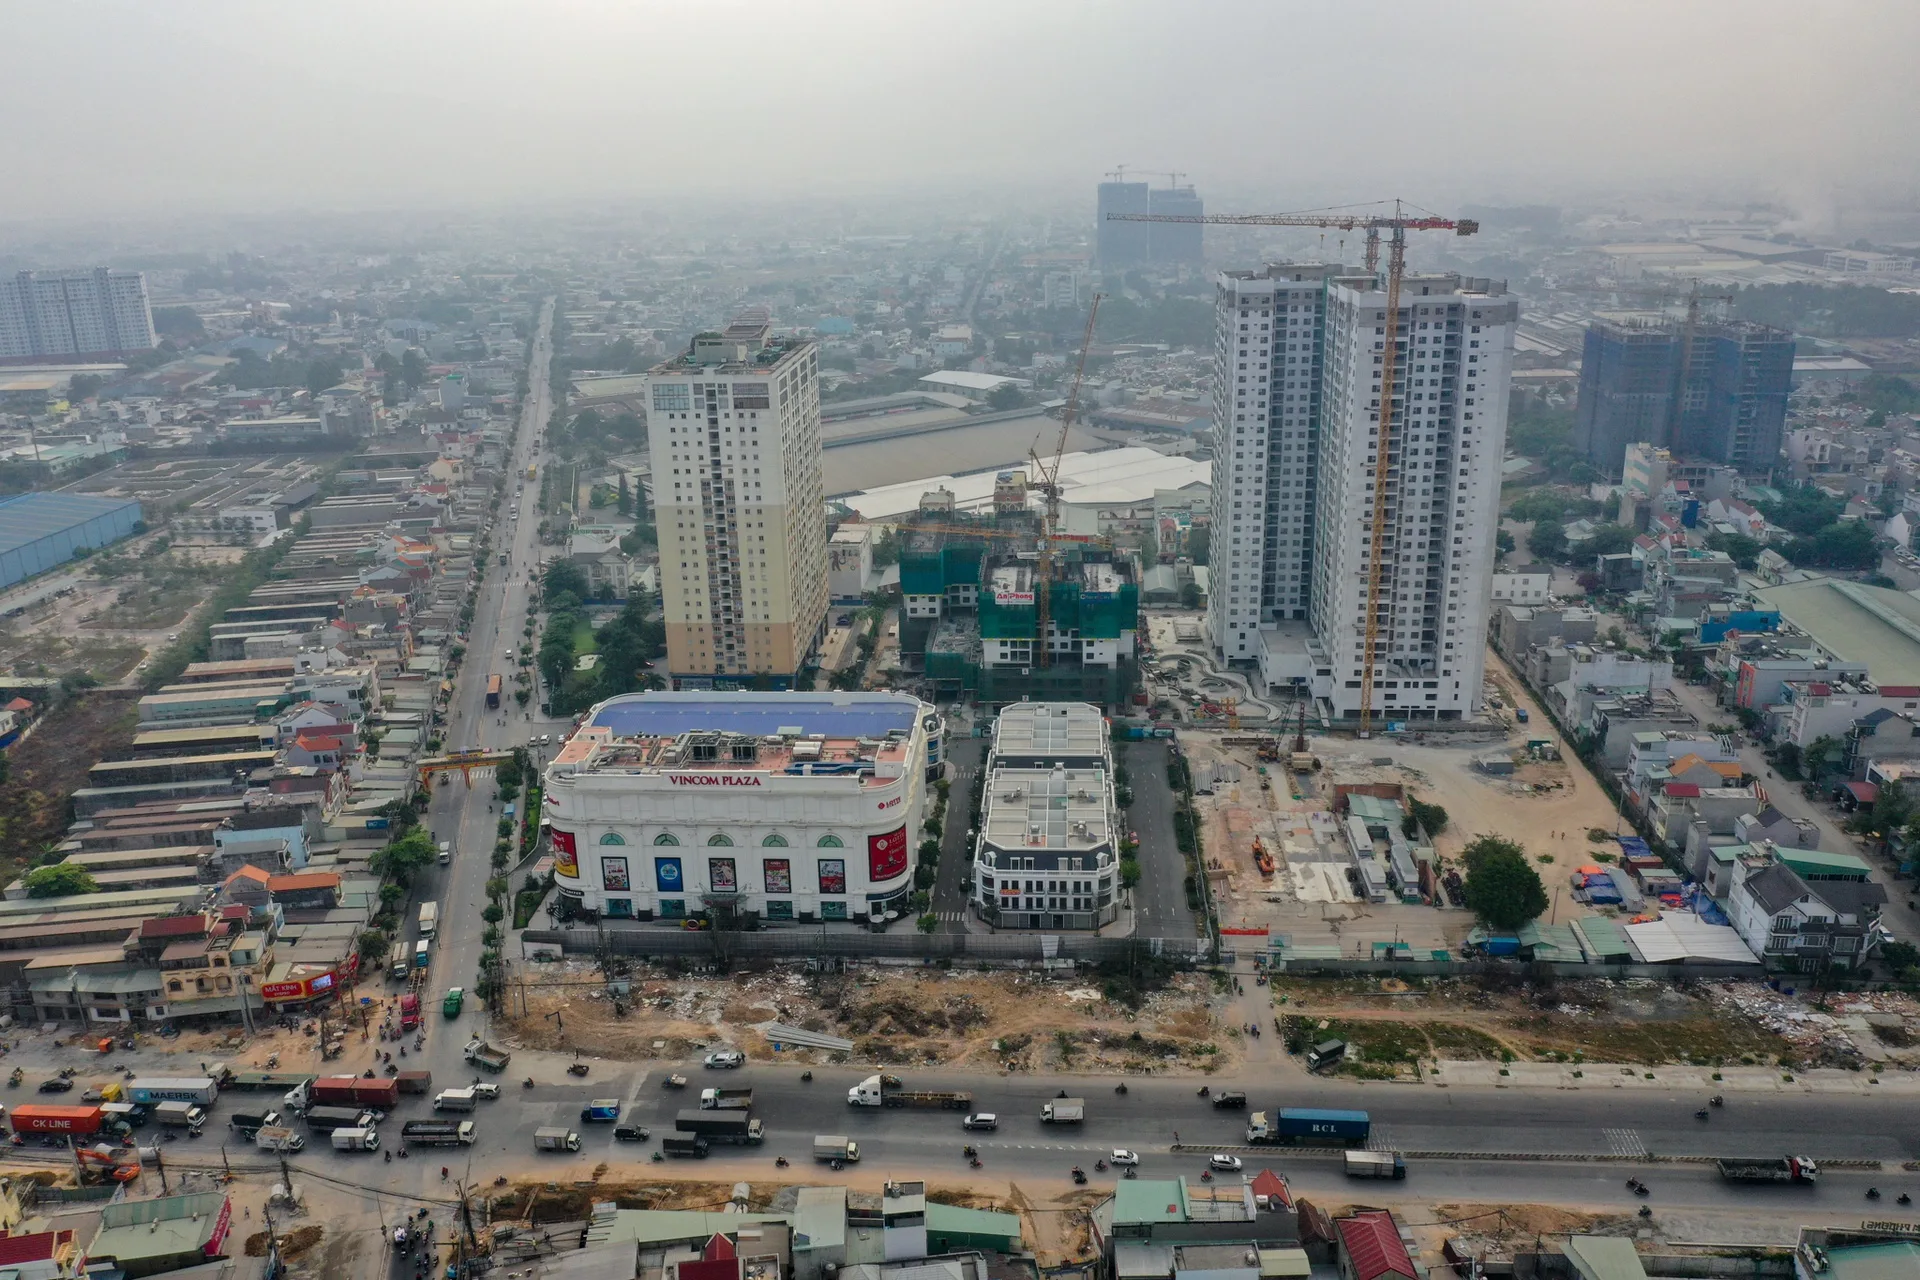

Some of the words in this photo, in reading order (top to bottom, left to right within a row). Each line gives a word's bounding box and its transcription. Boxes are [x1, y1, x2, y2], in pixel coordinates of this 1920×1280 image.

[1009, 593, 1033, 601] Phong
[669, 775, 721, 786] VINCOM
[722, 775, 761, 786] PLAZA
[150, 1091, 199, 1100] MAERSK
[32, 1119, 47, 1128] CK
[48, 1119, 71, 1129] LINE
[1311, 1123, 1337, 1133] RCL
